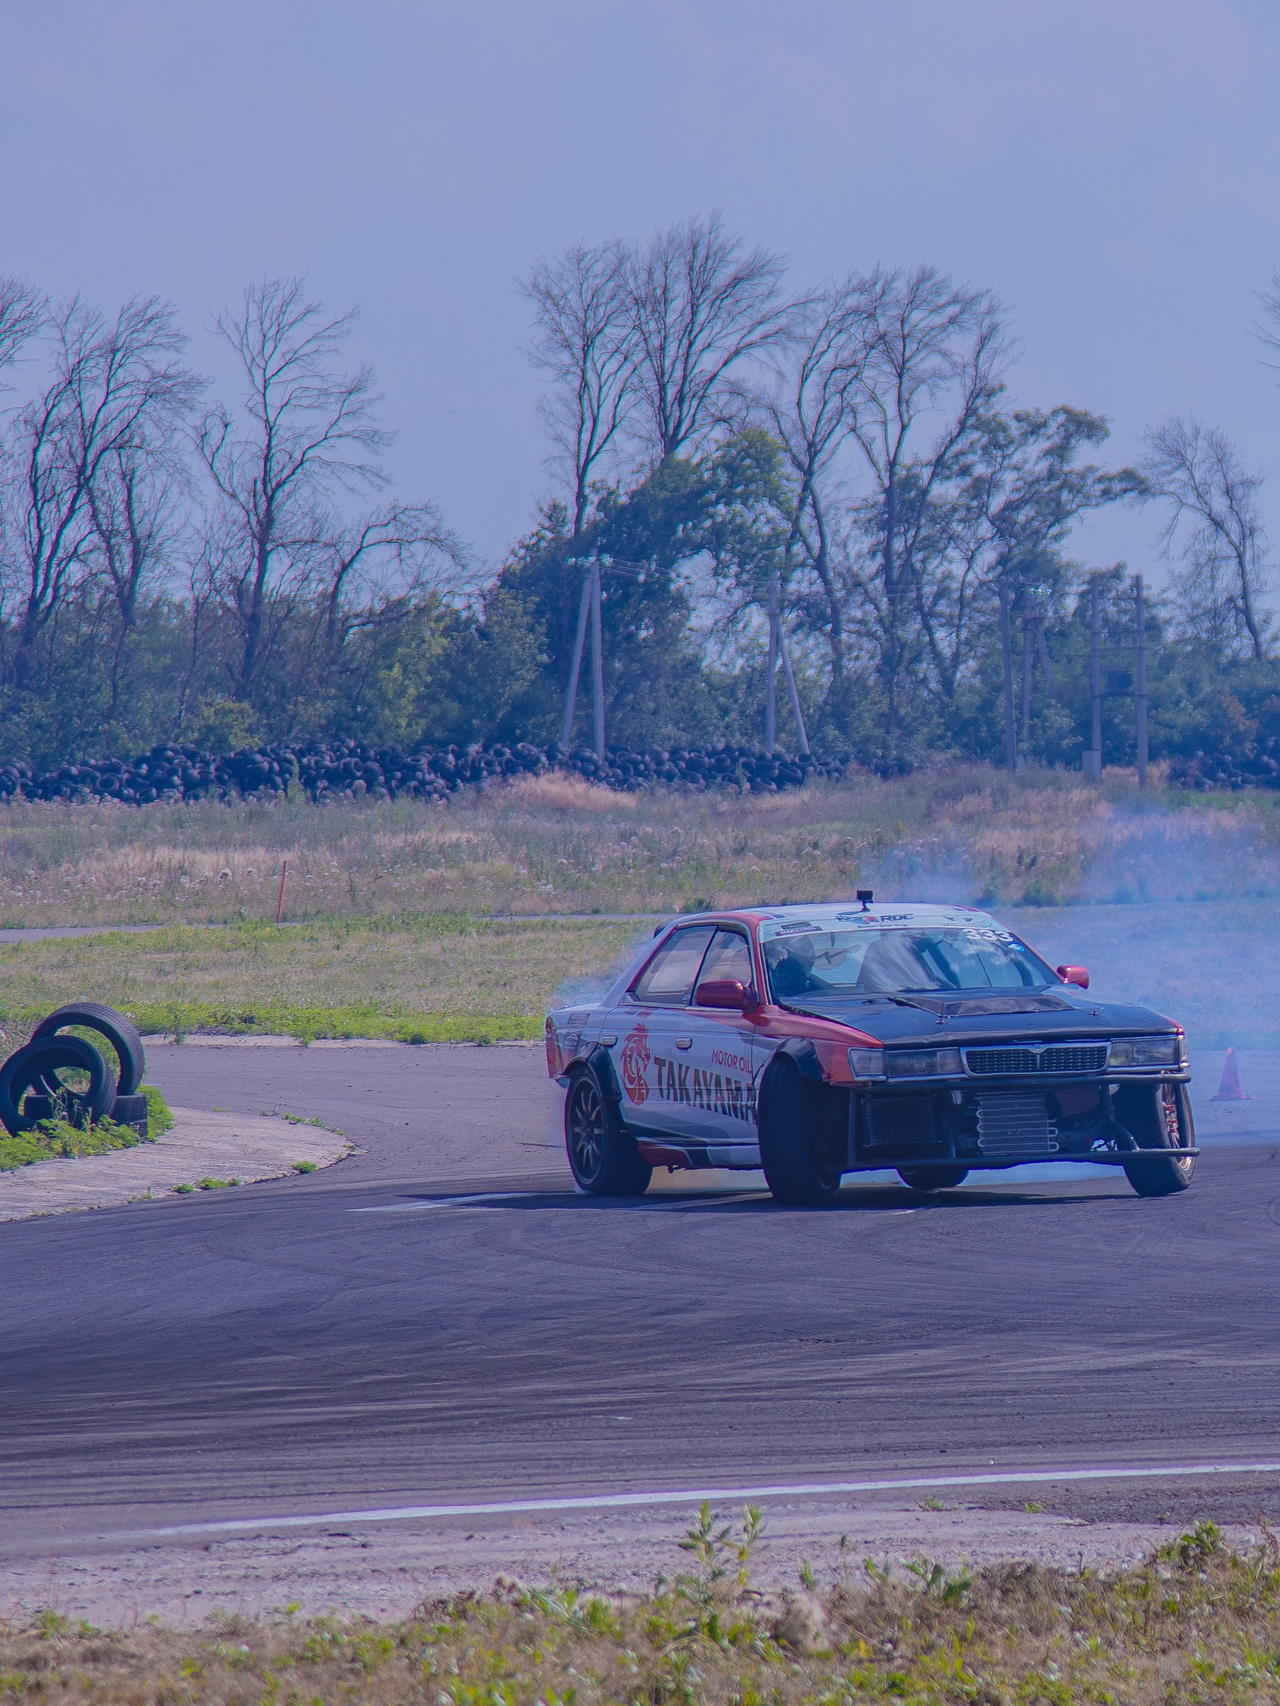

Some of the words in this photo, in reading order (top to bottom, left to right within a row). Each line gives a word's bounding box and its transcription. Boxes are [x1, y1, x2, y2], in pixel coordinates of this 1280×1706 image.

[880, 913, 914, 922] RDC
[961, 928, 1014, 942] 333
[711, 1048, 738, 1070] MOTOR
[738, 1057, 753, 1074] OIL
[653, 1056, 758, 1126] TAKAYAMA
